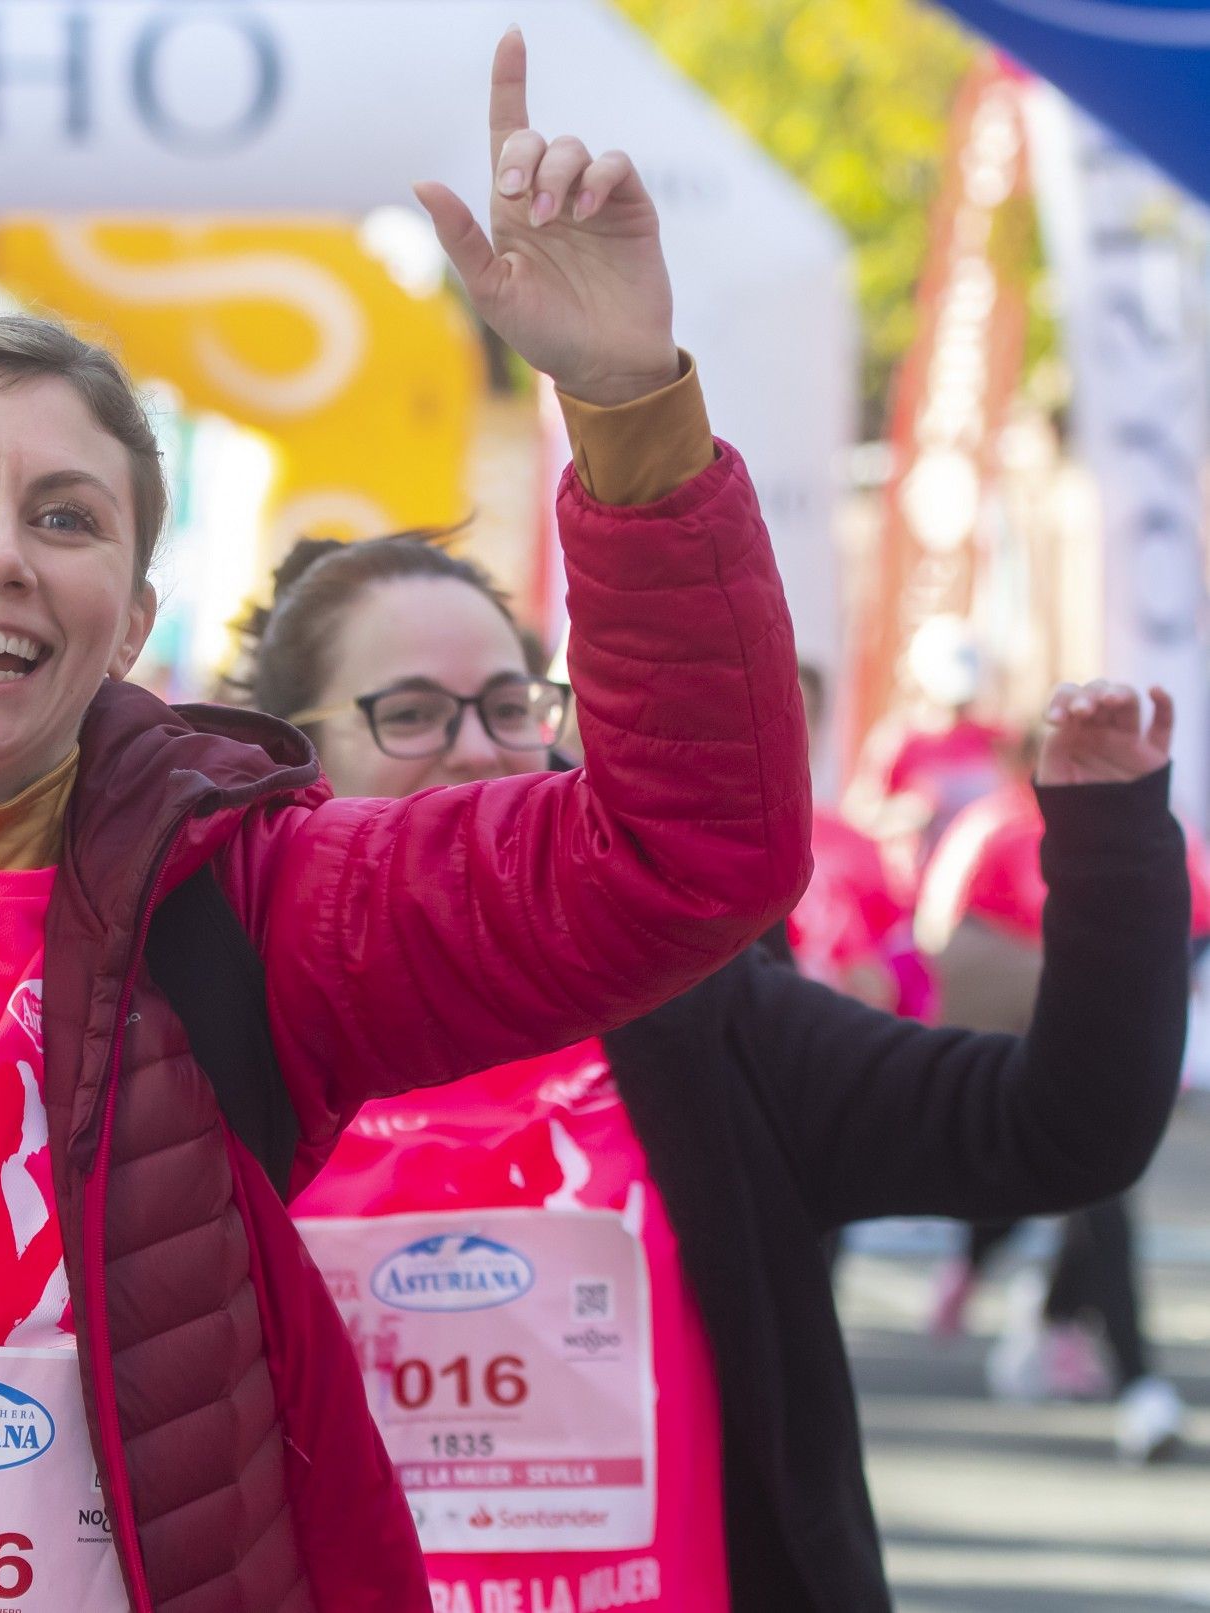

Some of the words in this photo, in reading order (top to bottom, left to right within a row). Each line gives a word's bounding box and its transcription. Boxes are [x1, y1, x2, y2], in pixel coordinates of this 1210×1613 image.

[385, 1268, 522, 1297] ASTURIANA
[392, 1353, 529, 1411] 016
[430, 1433, 495, 1458] 1835
[525, 1462, 596, 1486] SEVILLA
[498, 1506, 609, 1530] Santander
[480, 1577, 524, 1613] DE
[531, 1574, 576, 1613] LA
